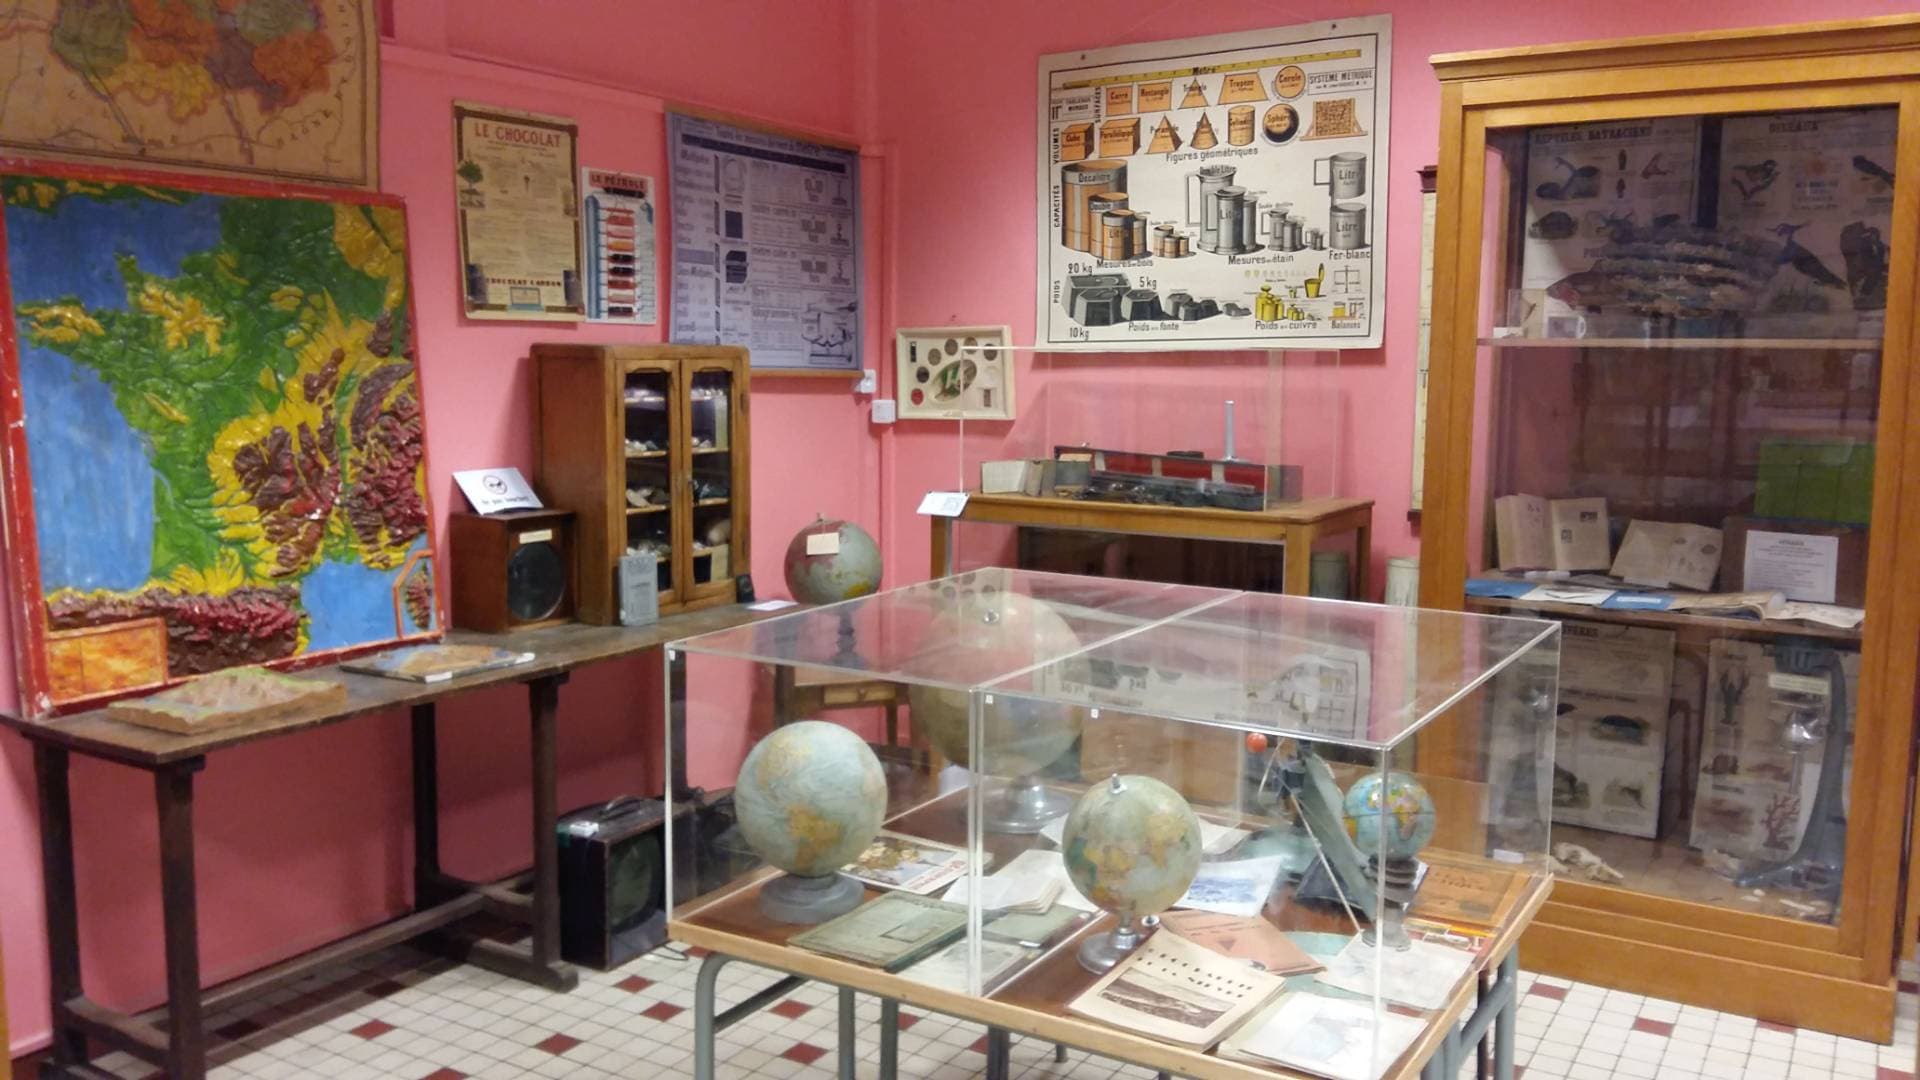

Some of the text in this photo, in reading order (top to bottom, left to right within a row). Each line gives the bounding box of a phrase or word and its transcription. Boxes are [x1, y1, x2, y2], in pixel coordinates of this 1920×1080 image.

[474, 122, 490, 138] LE
[495, 126, 561, 148] CHOCOLAT
[1166, 147, 1259, 165] Figures géométriques
[591, 174, 601, 183] LE
[1052, 184, 1060, 228] CAPACITÉS
[1335, 222, 1359, 233] Litre
[1228, 254, 1266, 265] Mesures
[1271, 254, 1294, 263] étain
[1328, 250, 1371, 261] Fer-blanc
[1067, 262, 1093, 276] 20 kg
[1096, 258, 1132, 268] Mesures
[1139, 276, 1157, 290] 5 kg
[1053, 280, 1061, 303] POIDS
[1128, 322, 1150, 331] Poids
[1159, 321, 1179, 331] fonte
[1255, 320, 1278, 330] Poids
[1289, 320, 1317, 330] cuivre
[1069, 327, 1090, 341] 10 kg
